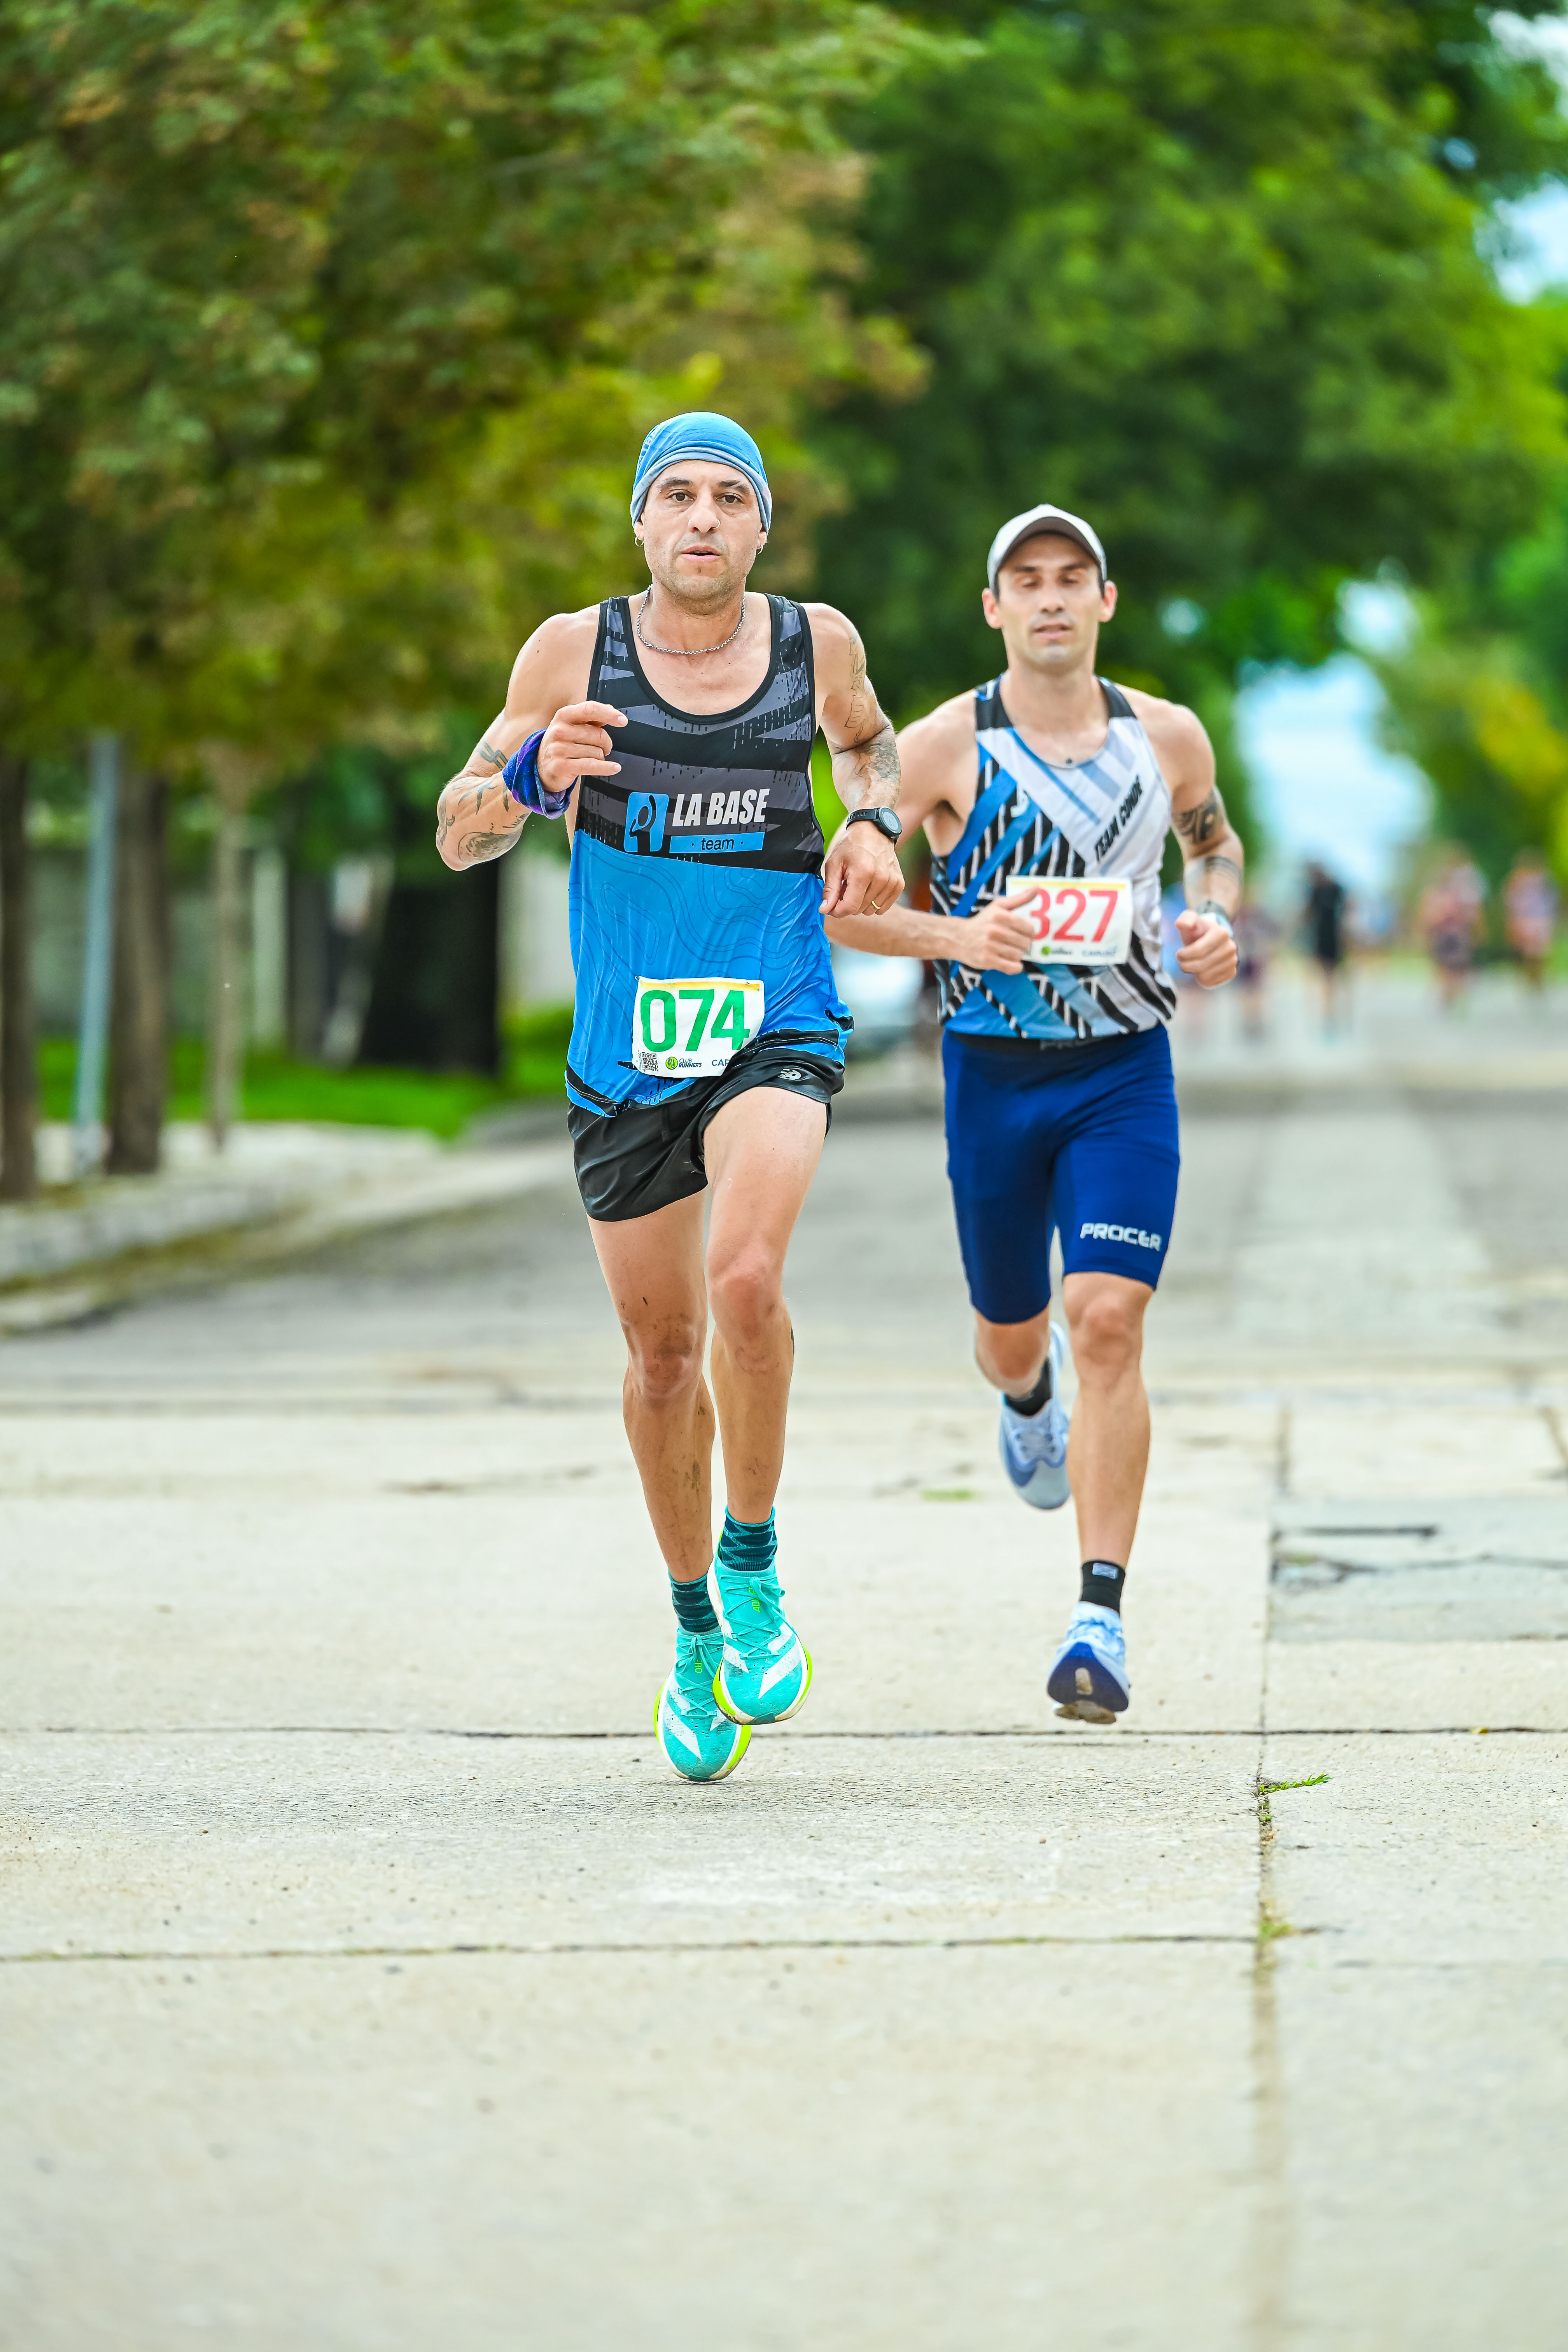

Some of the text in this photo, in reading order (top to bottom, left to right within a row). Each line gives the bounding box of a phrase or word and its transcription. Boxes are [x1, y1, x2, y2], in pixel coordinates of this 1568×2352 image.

[672, 788, 770, 827] LA BASE
[701, 837, 734, 850] team
[1094, 815, 1119, 862] TEAM
[1030, 888, 1118, 943] 327
[640, 989, 750, 1052] 074
